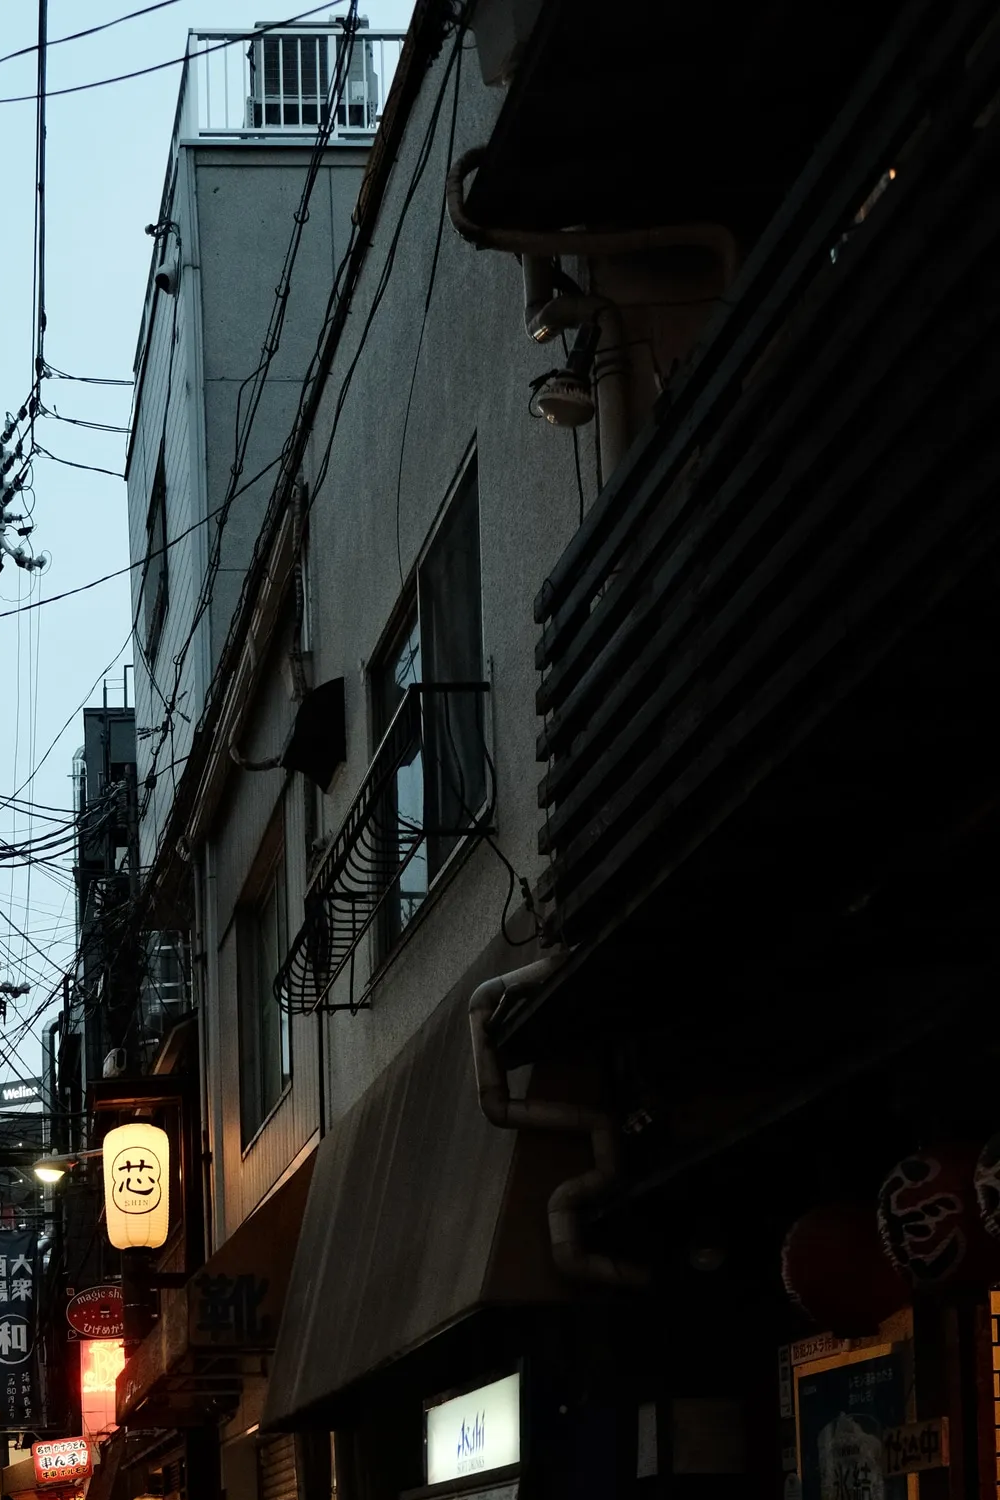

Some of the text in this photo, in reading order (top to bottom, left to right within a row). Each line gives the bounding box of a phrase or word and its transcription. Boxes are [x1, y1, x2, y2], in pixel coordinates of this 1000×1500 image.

[2, 1084, 38, 1101] Welina
[117, 1159, 156, 1196] 芯
[123, 1199, 150, 1207] SHIN
[76, 1288, 106, 1305] magic
[456, 1409, 486, 1459] Asahi
